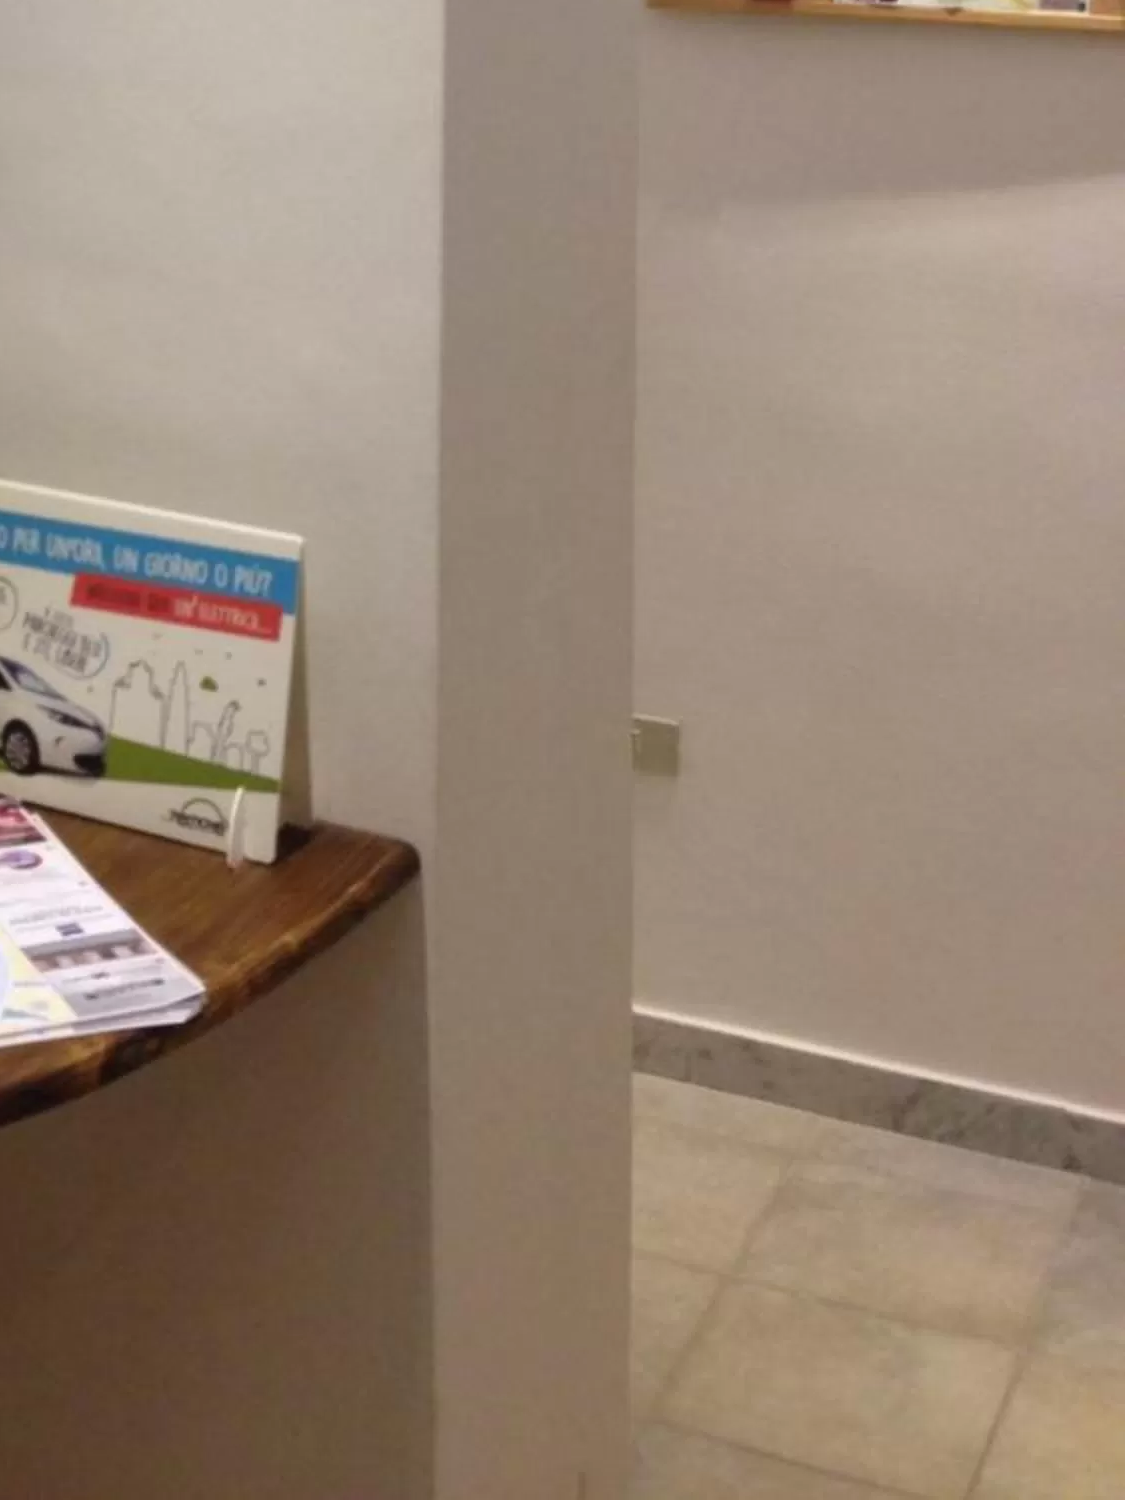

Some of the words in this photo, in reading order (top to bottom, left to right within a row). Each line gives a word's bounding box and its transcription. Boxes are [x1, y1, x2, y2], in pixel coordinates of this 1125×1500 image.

[12, 528, 41, 554] PER
[113, 544, 140, 572] UN
[144, 552, 209, 585] GIORNO
[213, 563, 228, 588] O
